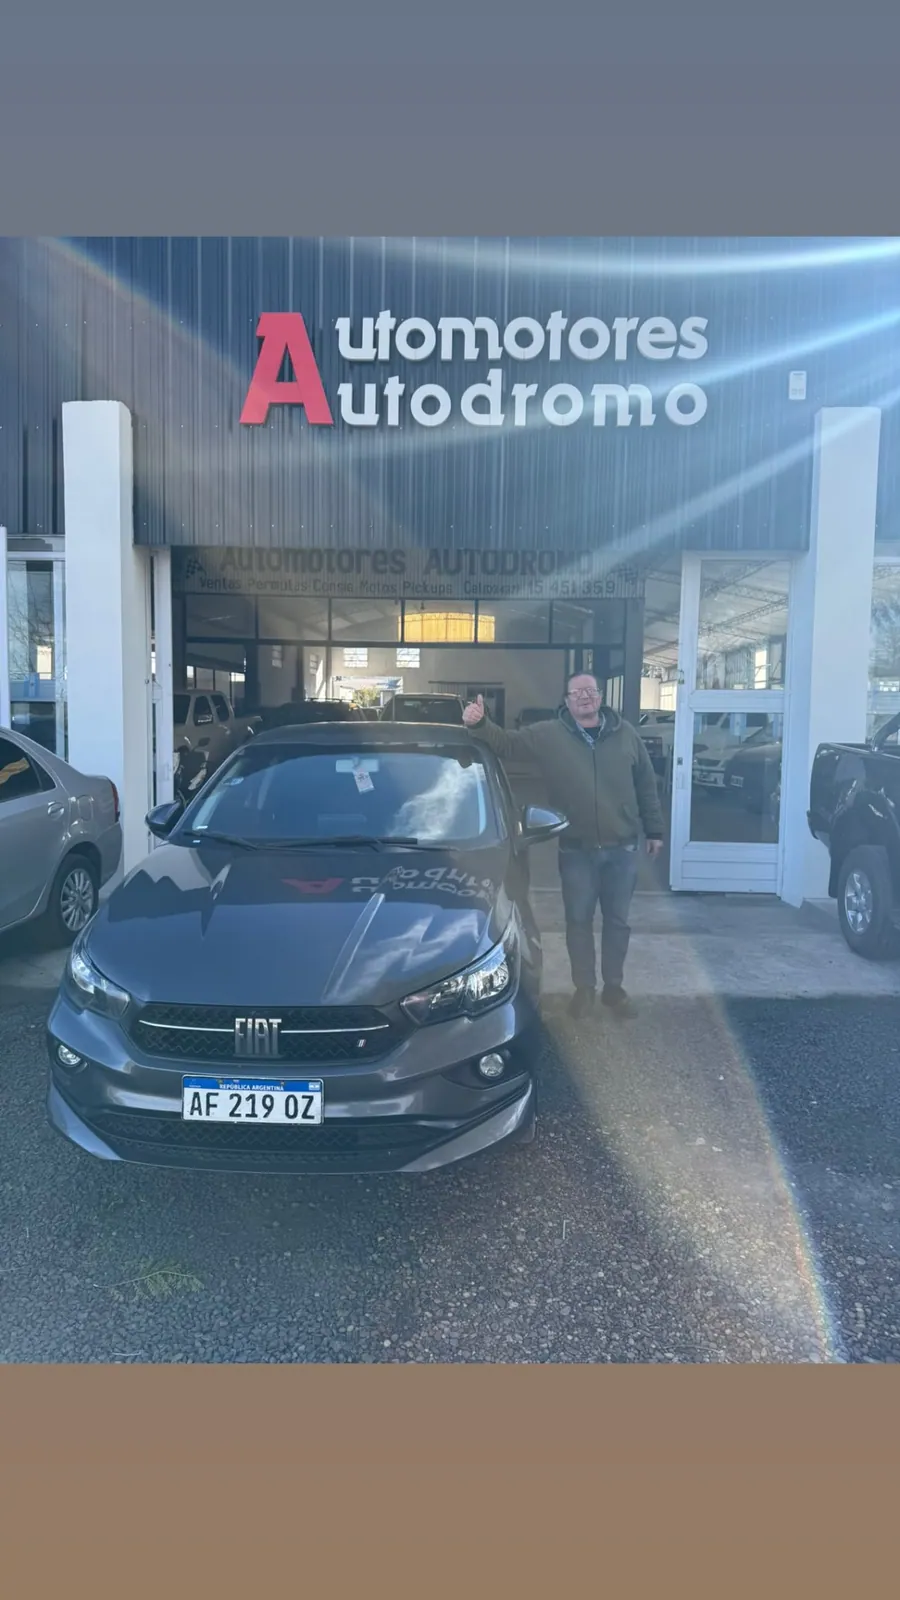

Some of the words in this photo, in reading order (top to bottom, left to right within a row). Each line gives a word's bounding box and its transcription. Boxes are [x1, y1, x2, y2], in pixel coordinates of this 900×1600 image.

[199, 577, 242, 592] Ventas
[234, 1018, 282, 1056] FIAT
[189, 1091, 219, 1116] AF
[229, 1093, 274, 1118] 219
